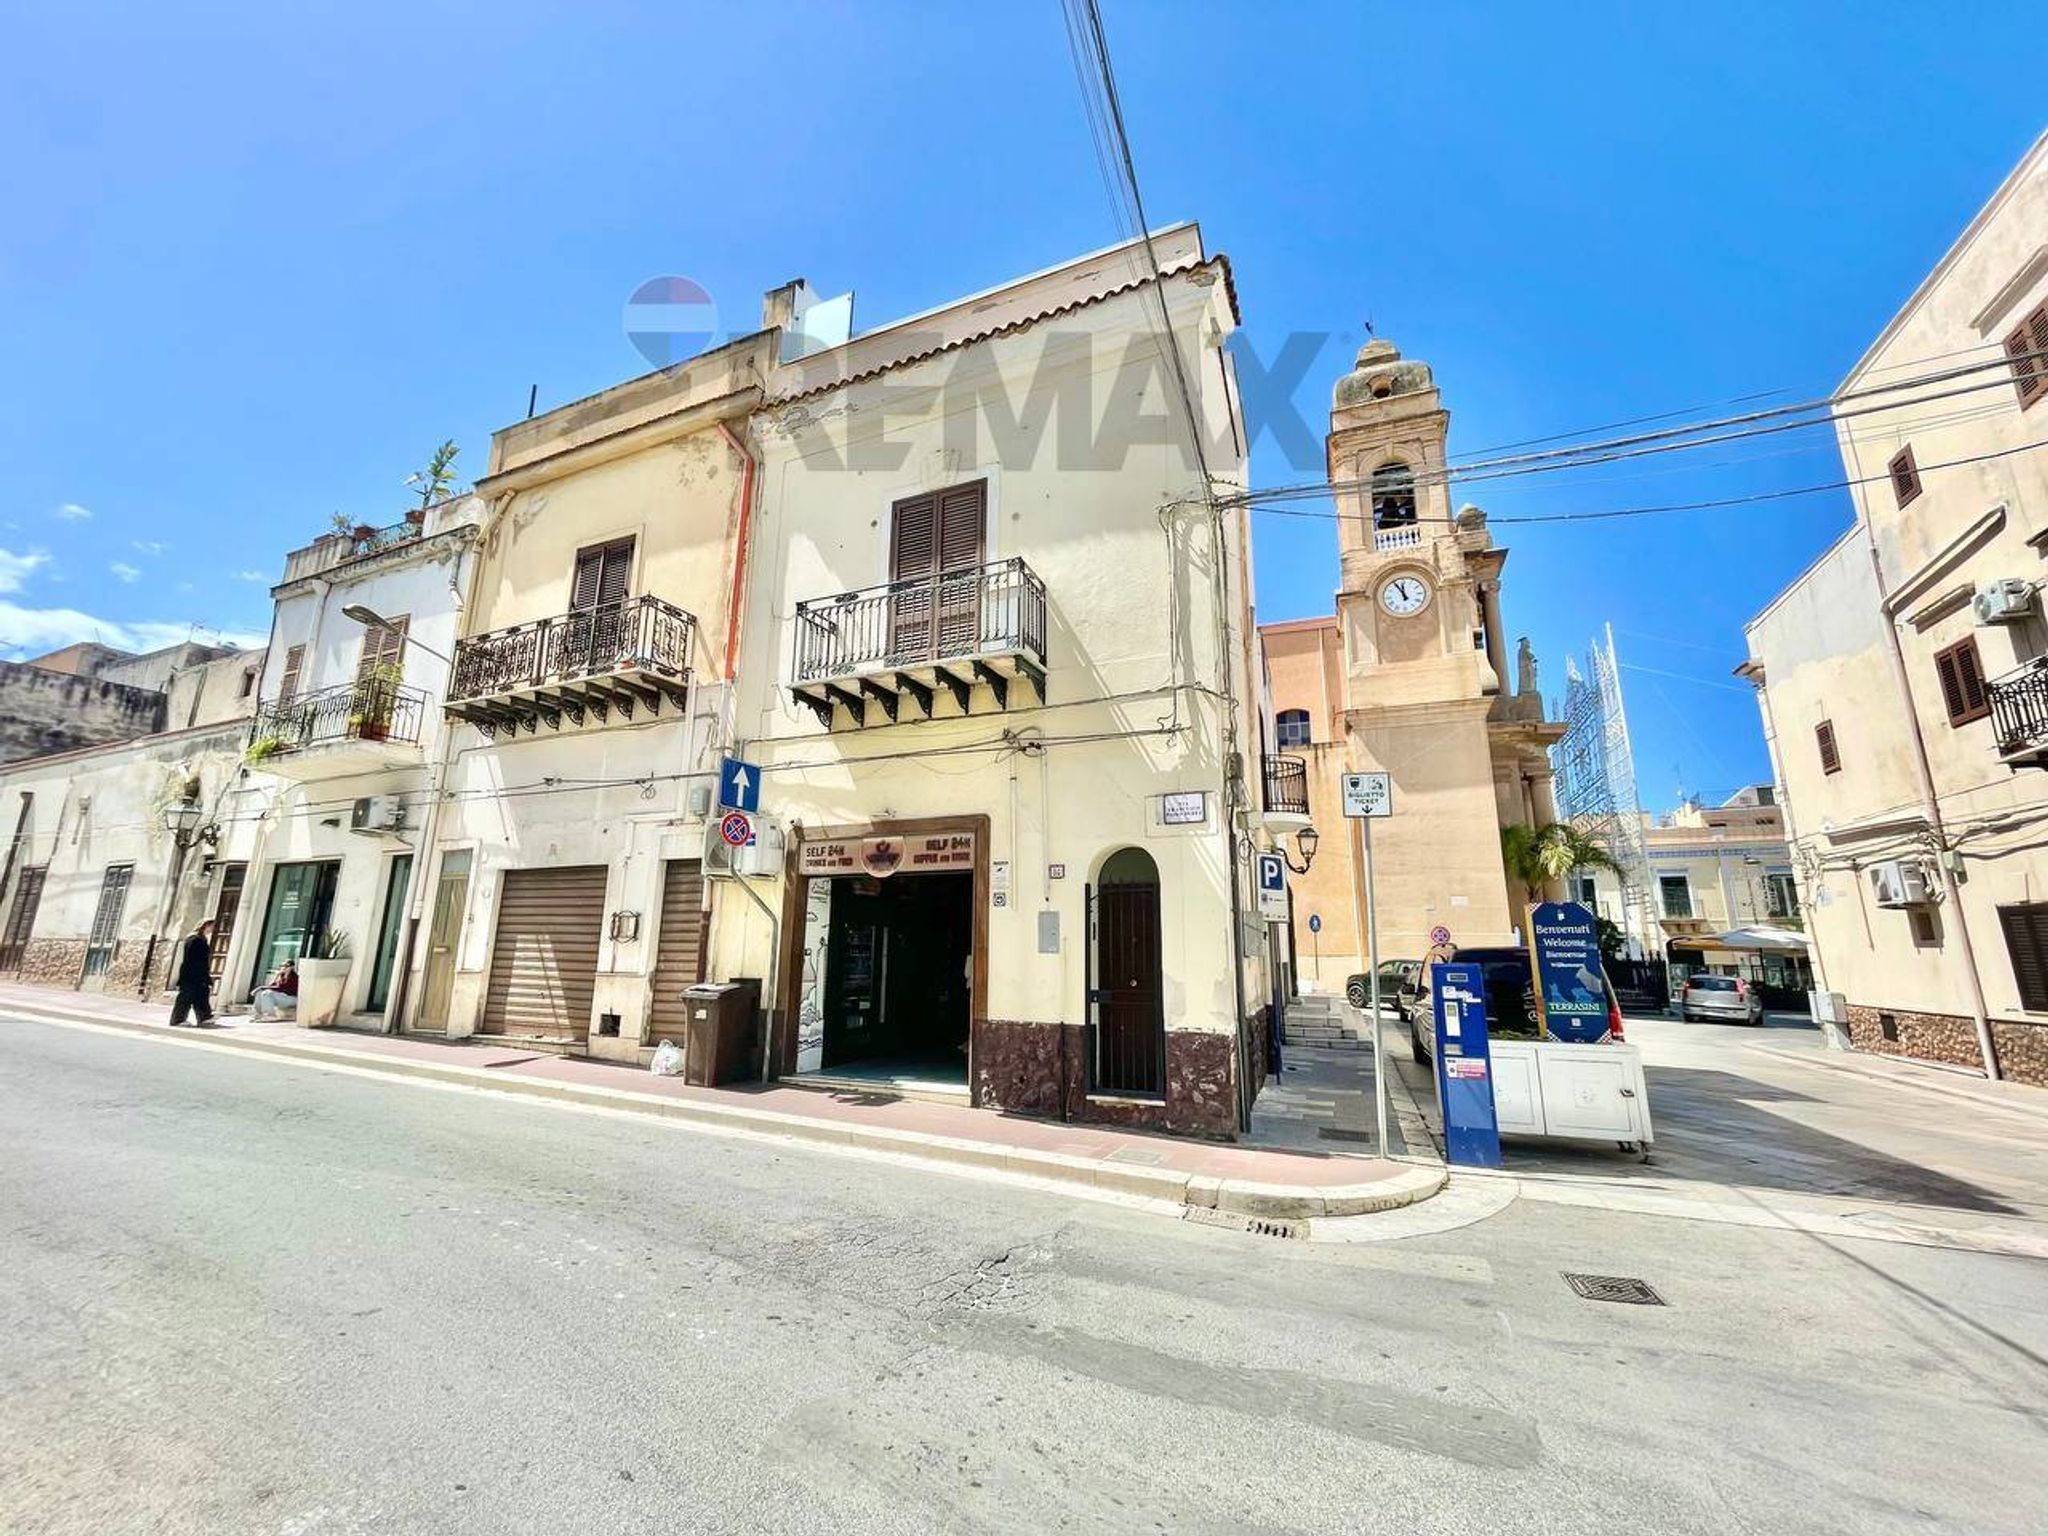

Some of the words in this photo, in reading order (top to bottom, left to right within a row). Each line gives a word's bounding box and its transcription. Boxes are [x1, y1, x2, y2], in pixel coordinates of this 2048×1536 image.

[806, 846, 826, 857] SELF
[1264, 860, 1278, 886] P
[1536, 924, 1590, 934] Benvenuti
[1550, 1003, 1600, 1011] TERRASINI
